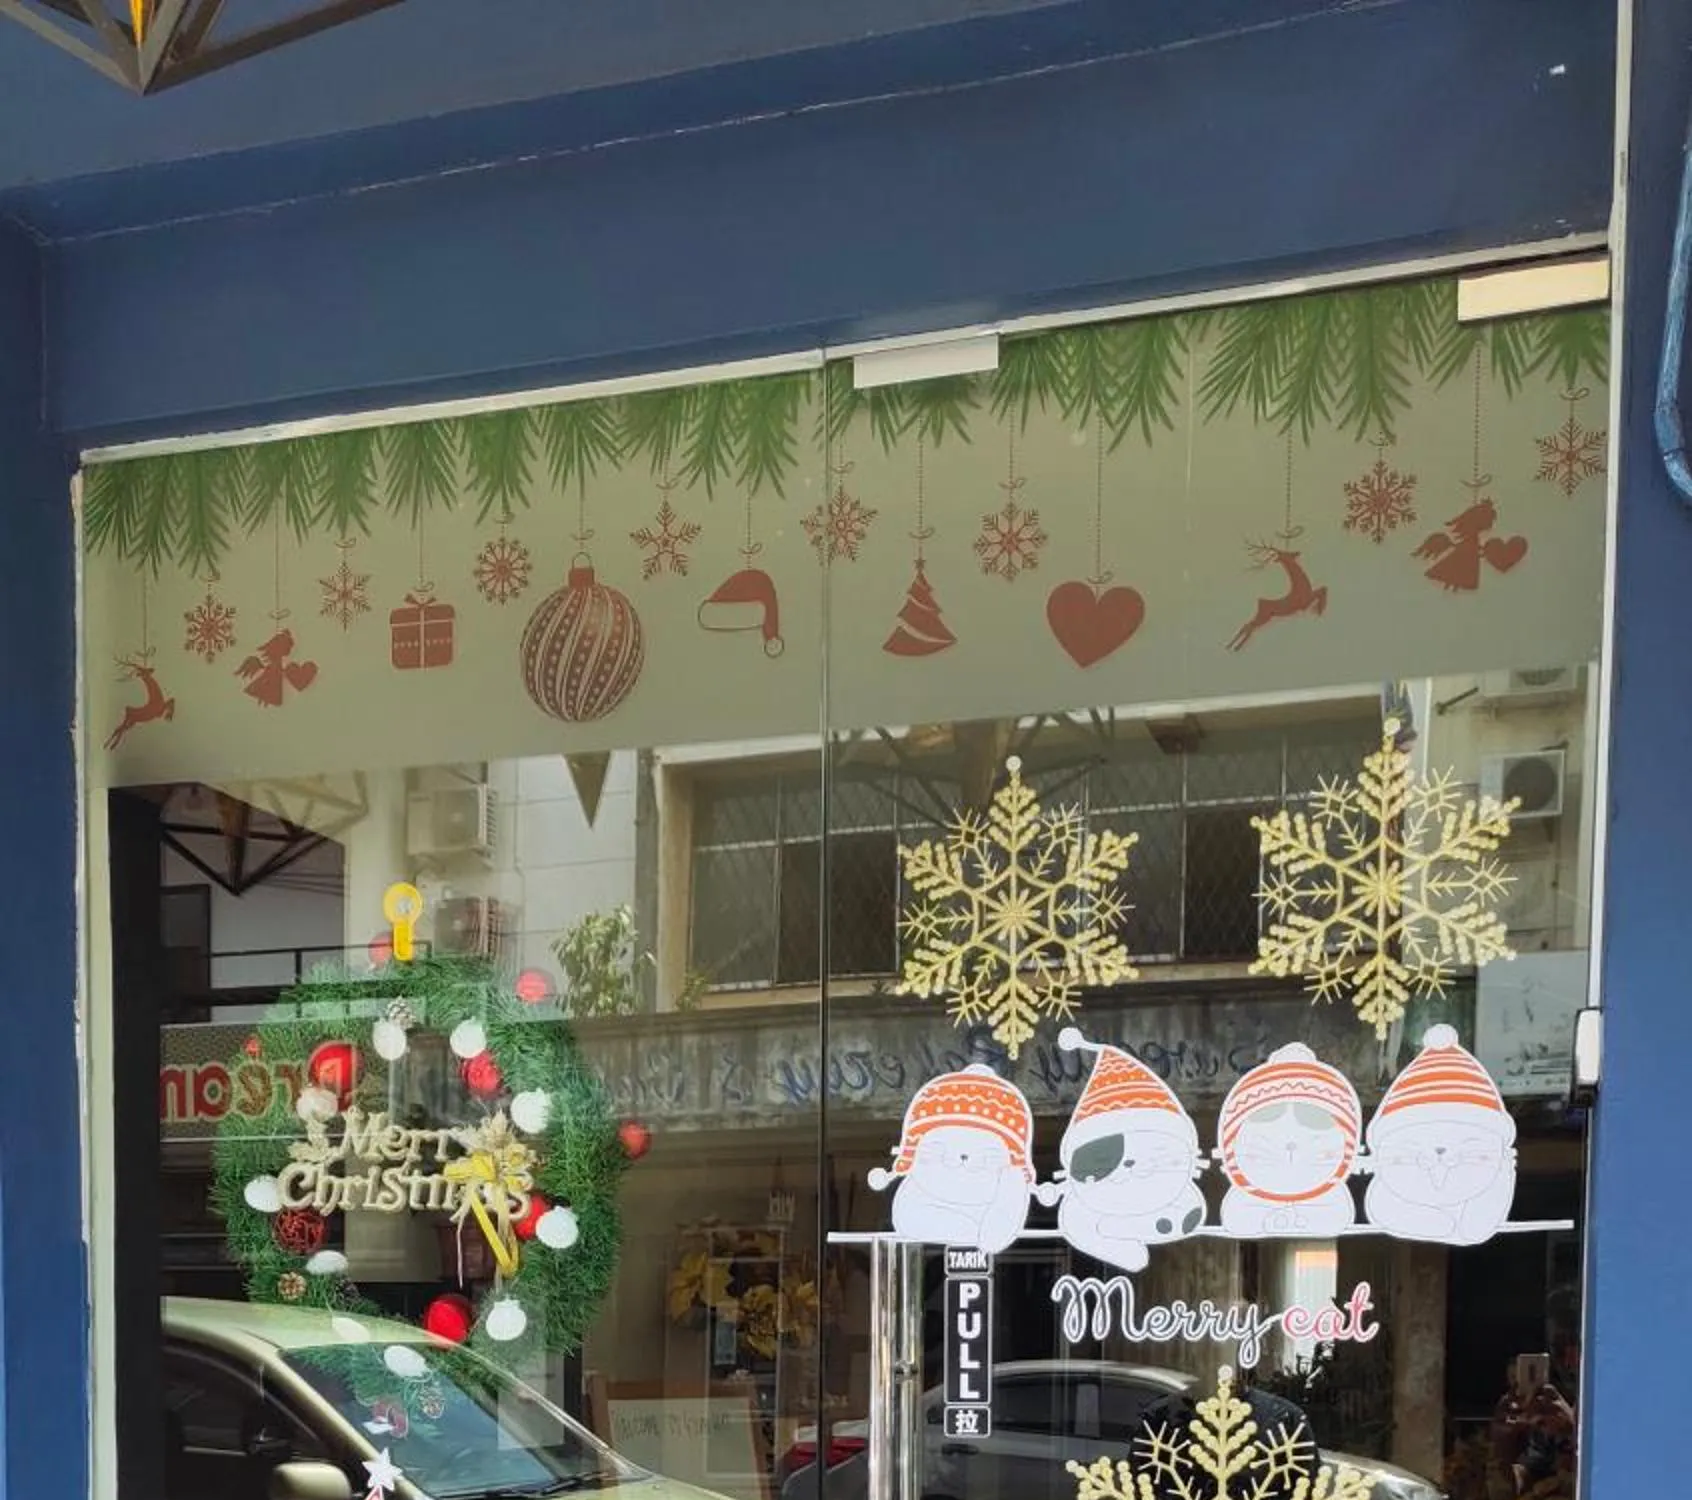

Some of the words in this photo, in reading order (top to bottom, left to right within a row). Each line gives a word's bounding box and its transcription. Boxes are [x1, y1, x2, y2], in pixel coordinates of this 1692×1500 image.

[334, 1105, 472, 1163] Merr
[950, 1251, 987, 1270] TARIK
[957, 1282, 982, 1400] PULL
[1050, 1275, 1280, 1369] Merry
[1281, 1281, 1380, 1343] cat
[955, 1409, 979, 1435] 拉
